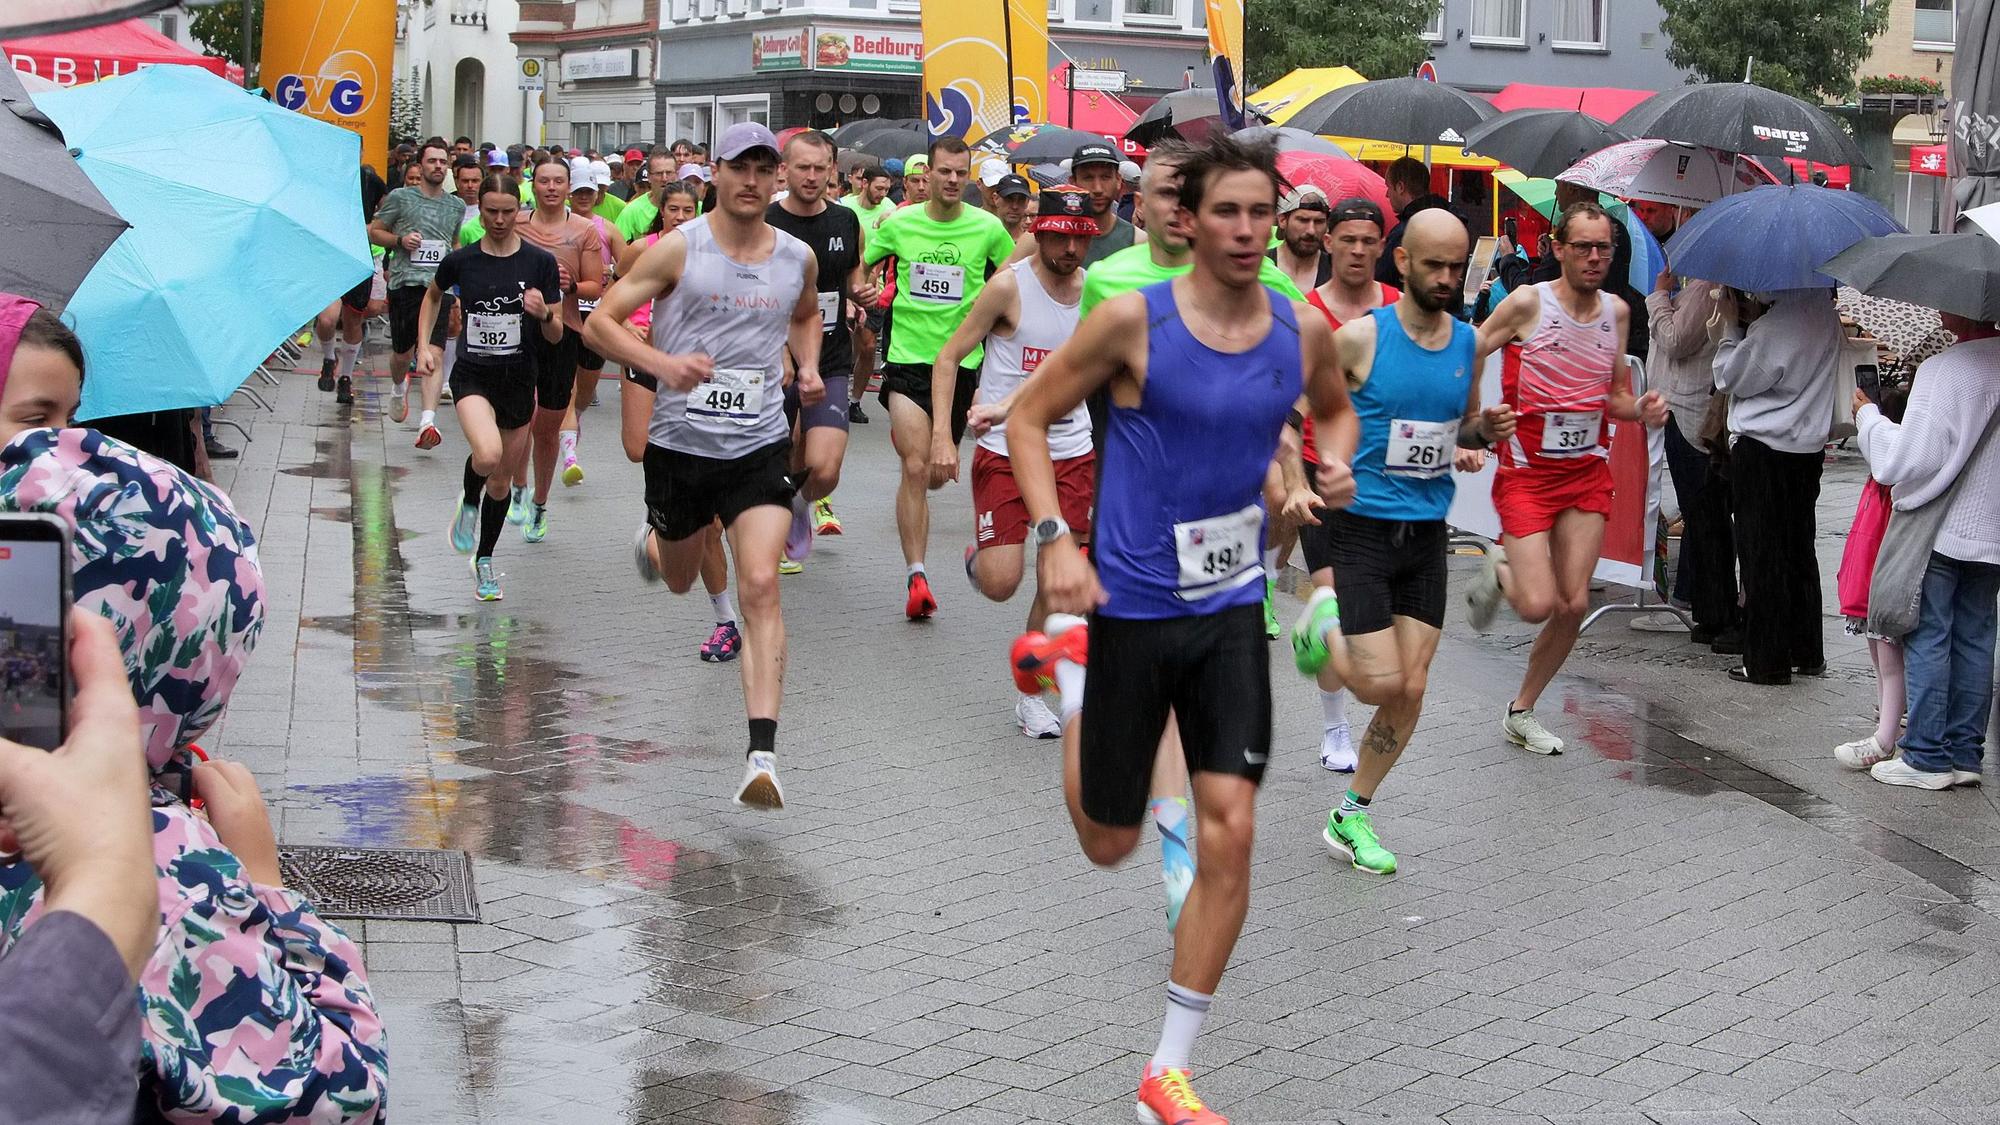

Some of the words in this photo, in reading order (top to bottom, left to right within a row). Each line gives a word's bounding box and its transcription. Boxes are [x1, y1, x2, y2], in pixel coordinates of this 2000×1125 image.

[1752, 124, 1809, 142] mares
[418, 250, 440, 261] 749
[921, 279, 950, 295] 459
[735, 295, 780, 309] MUNA
[479, 331, 508, 346] 382
[705, 390, 746, 411] 494
[1559, 428, 1589, 448] 337
[1406, 444, 1444, 466] 261
